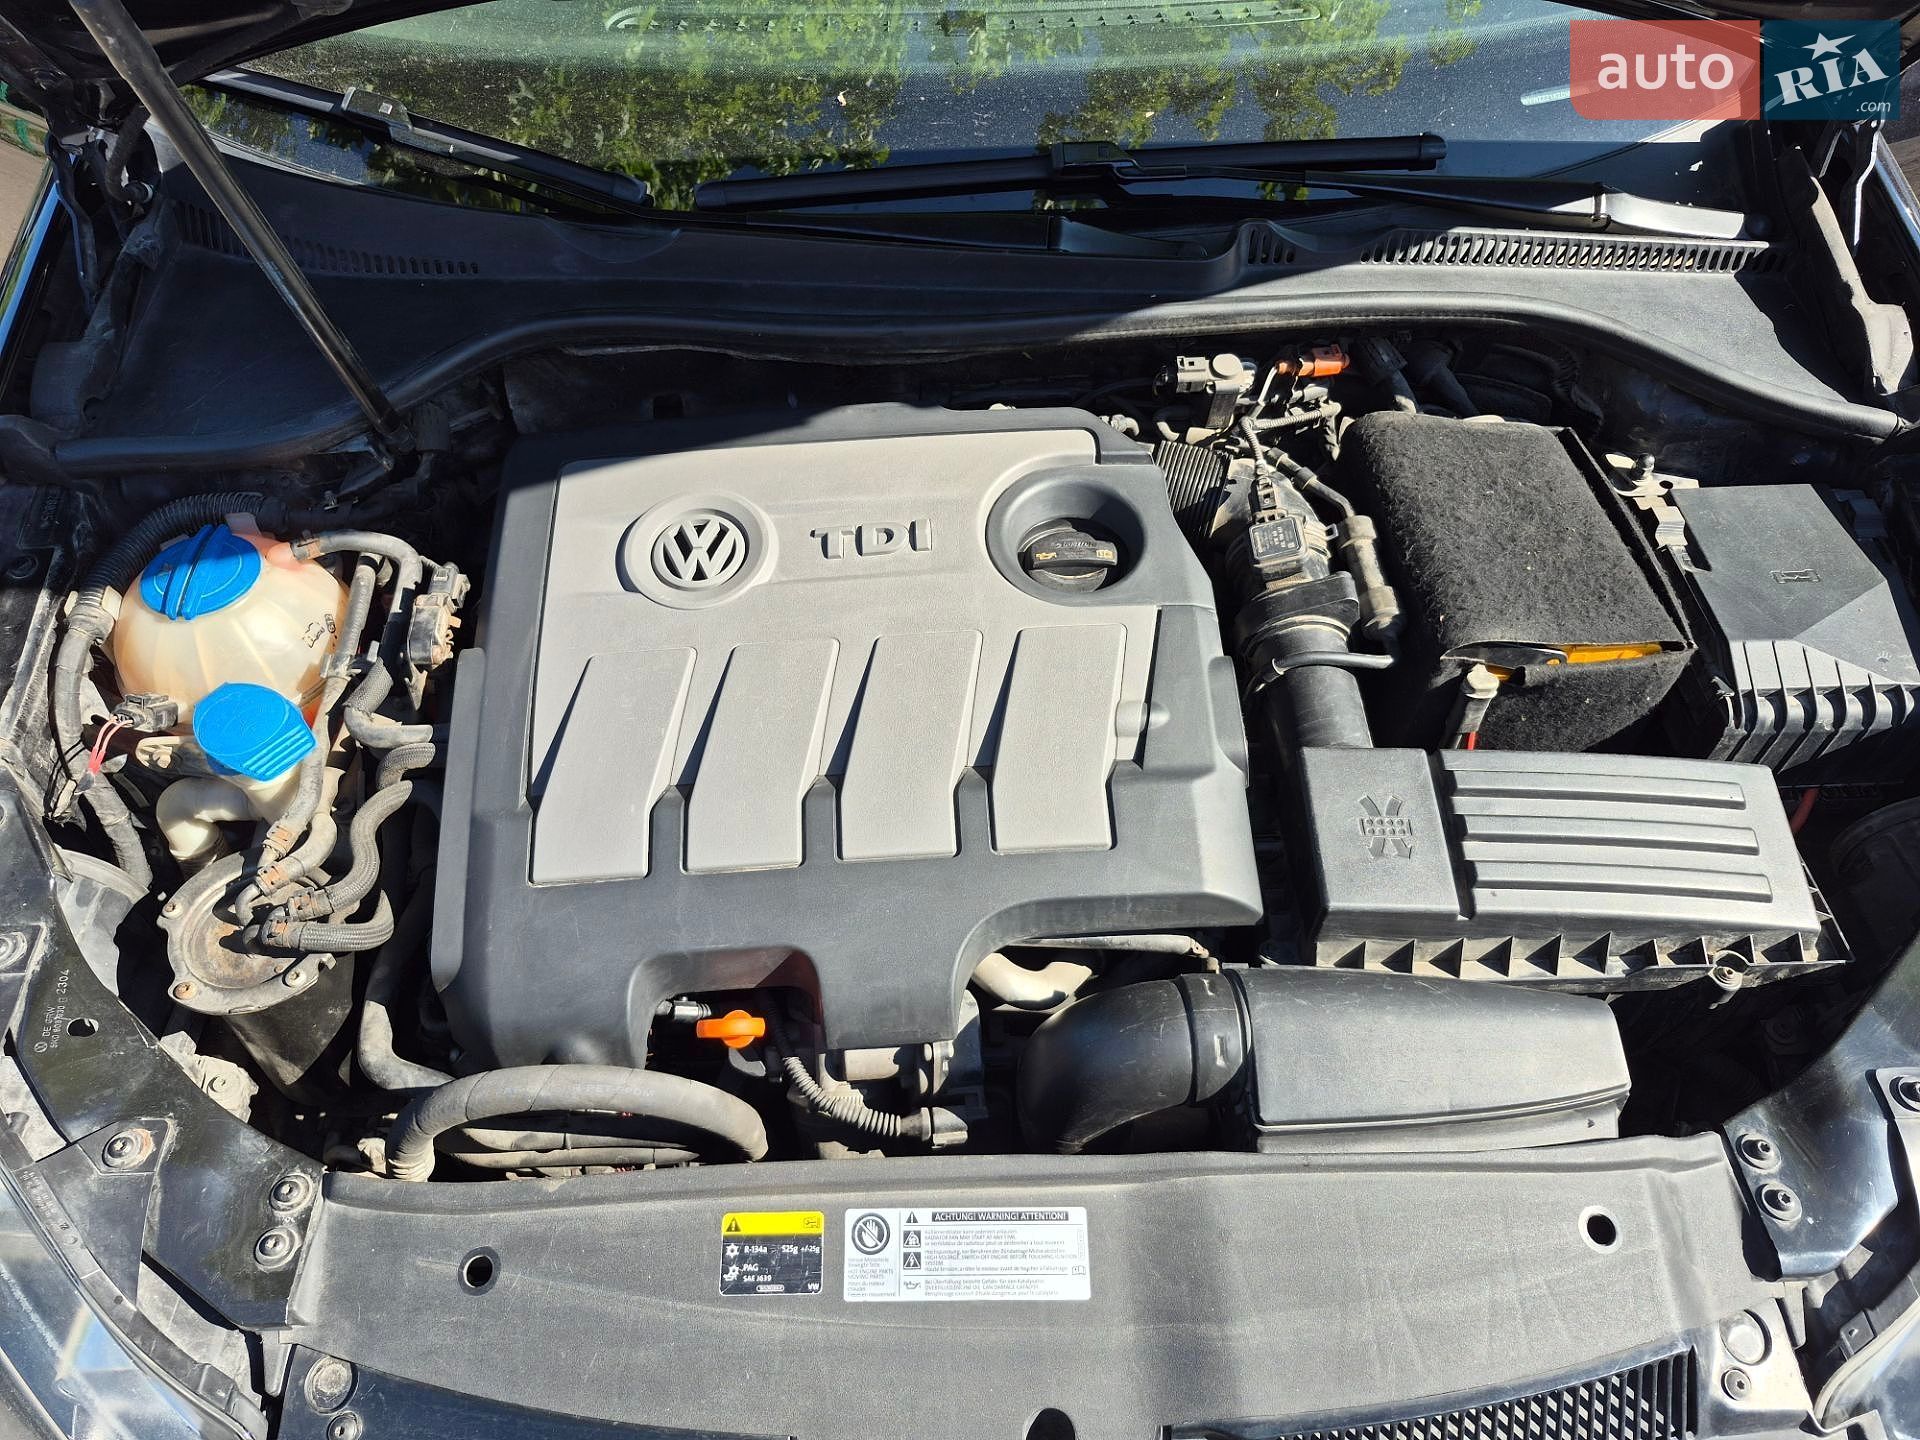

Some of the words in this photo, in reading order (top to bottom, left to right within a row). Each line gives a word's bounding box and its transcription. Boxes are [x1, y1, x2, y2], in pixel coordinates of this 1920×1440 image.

[809, 518, 932, 560] TDI
[934, 1211, 977, 1221] ACHTUNG!
[978, 1211, 1019, 1221] WARNING!
[1020, 1211, 1066, 1220] ATTENTION!
[744, 1245, 768, 1253] R-134a
[781, 1244, 799, 1255] 525g
[743, 1263, 759, 1272] PAG
